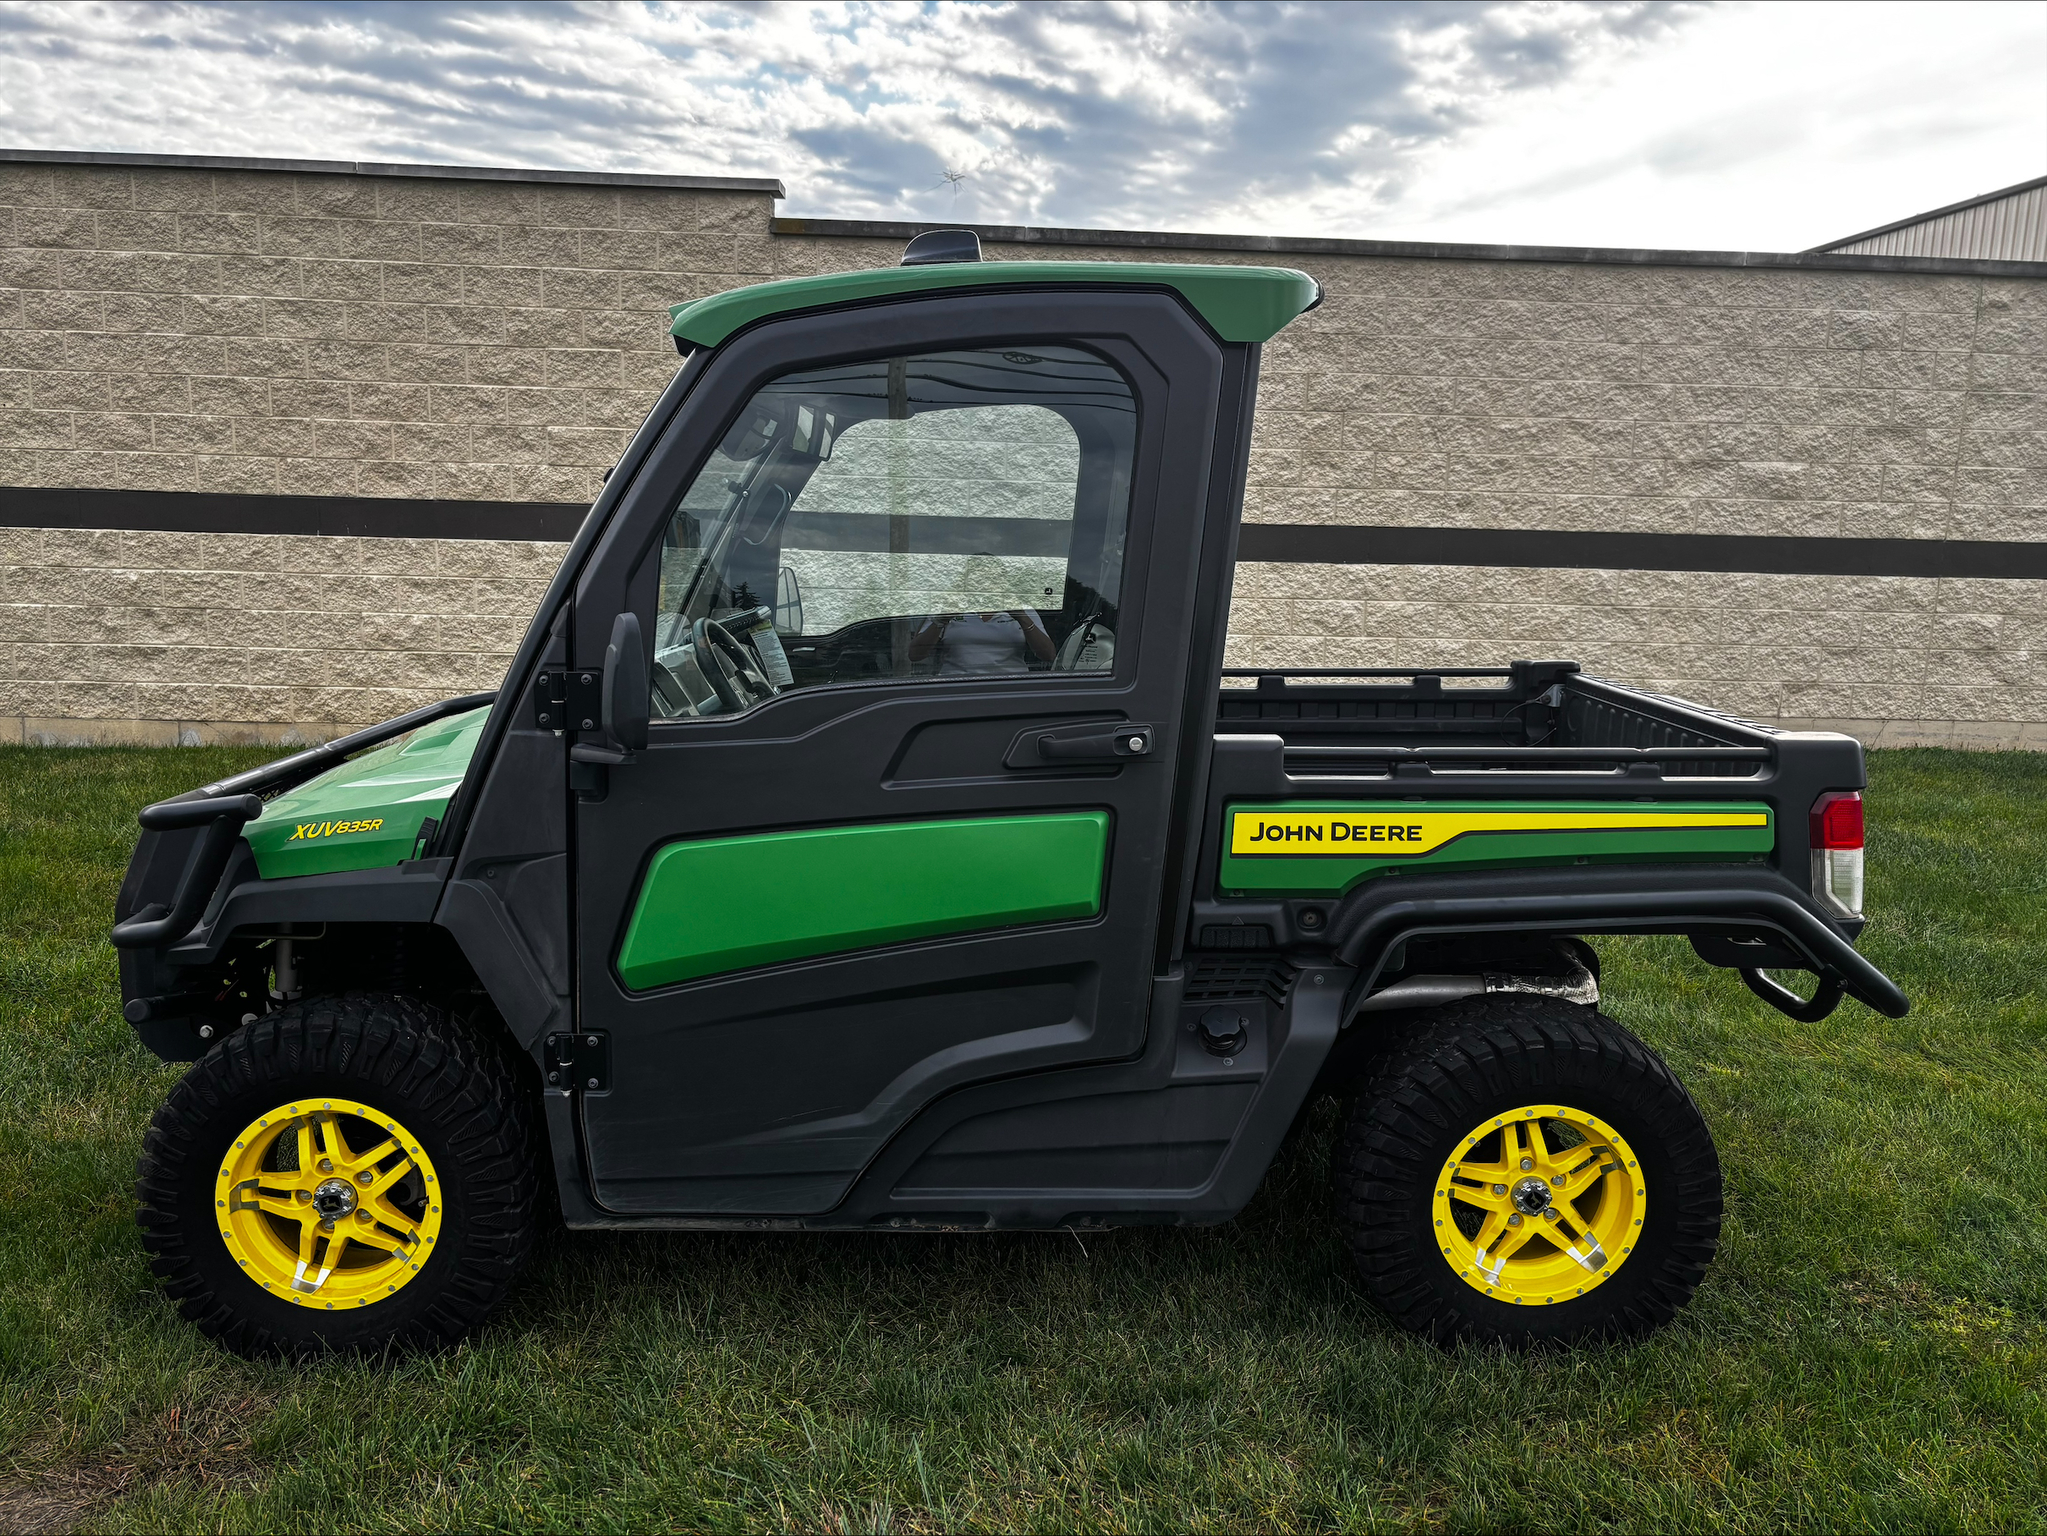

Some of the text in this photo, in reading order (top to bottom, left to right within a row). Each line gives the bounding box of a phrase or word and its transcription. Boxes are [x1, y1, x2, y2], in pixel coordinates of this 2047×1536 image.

[287, 818, 384, 841] XUV835R
[1249, 822, 1423, 842] JOHN DEERE
